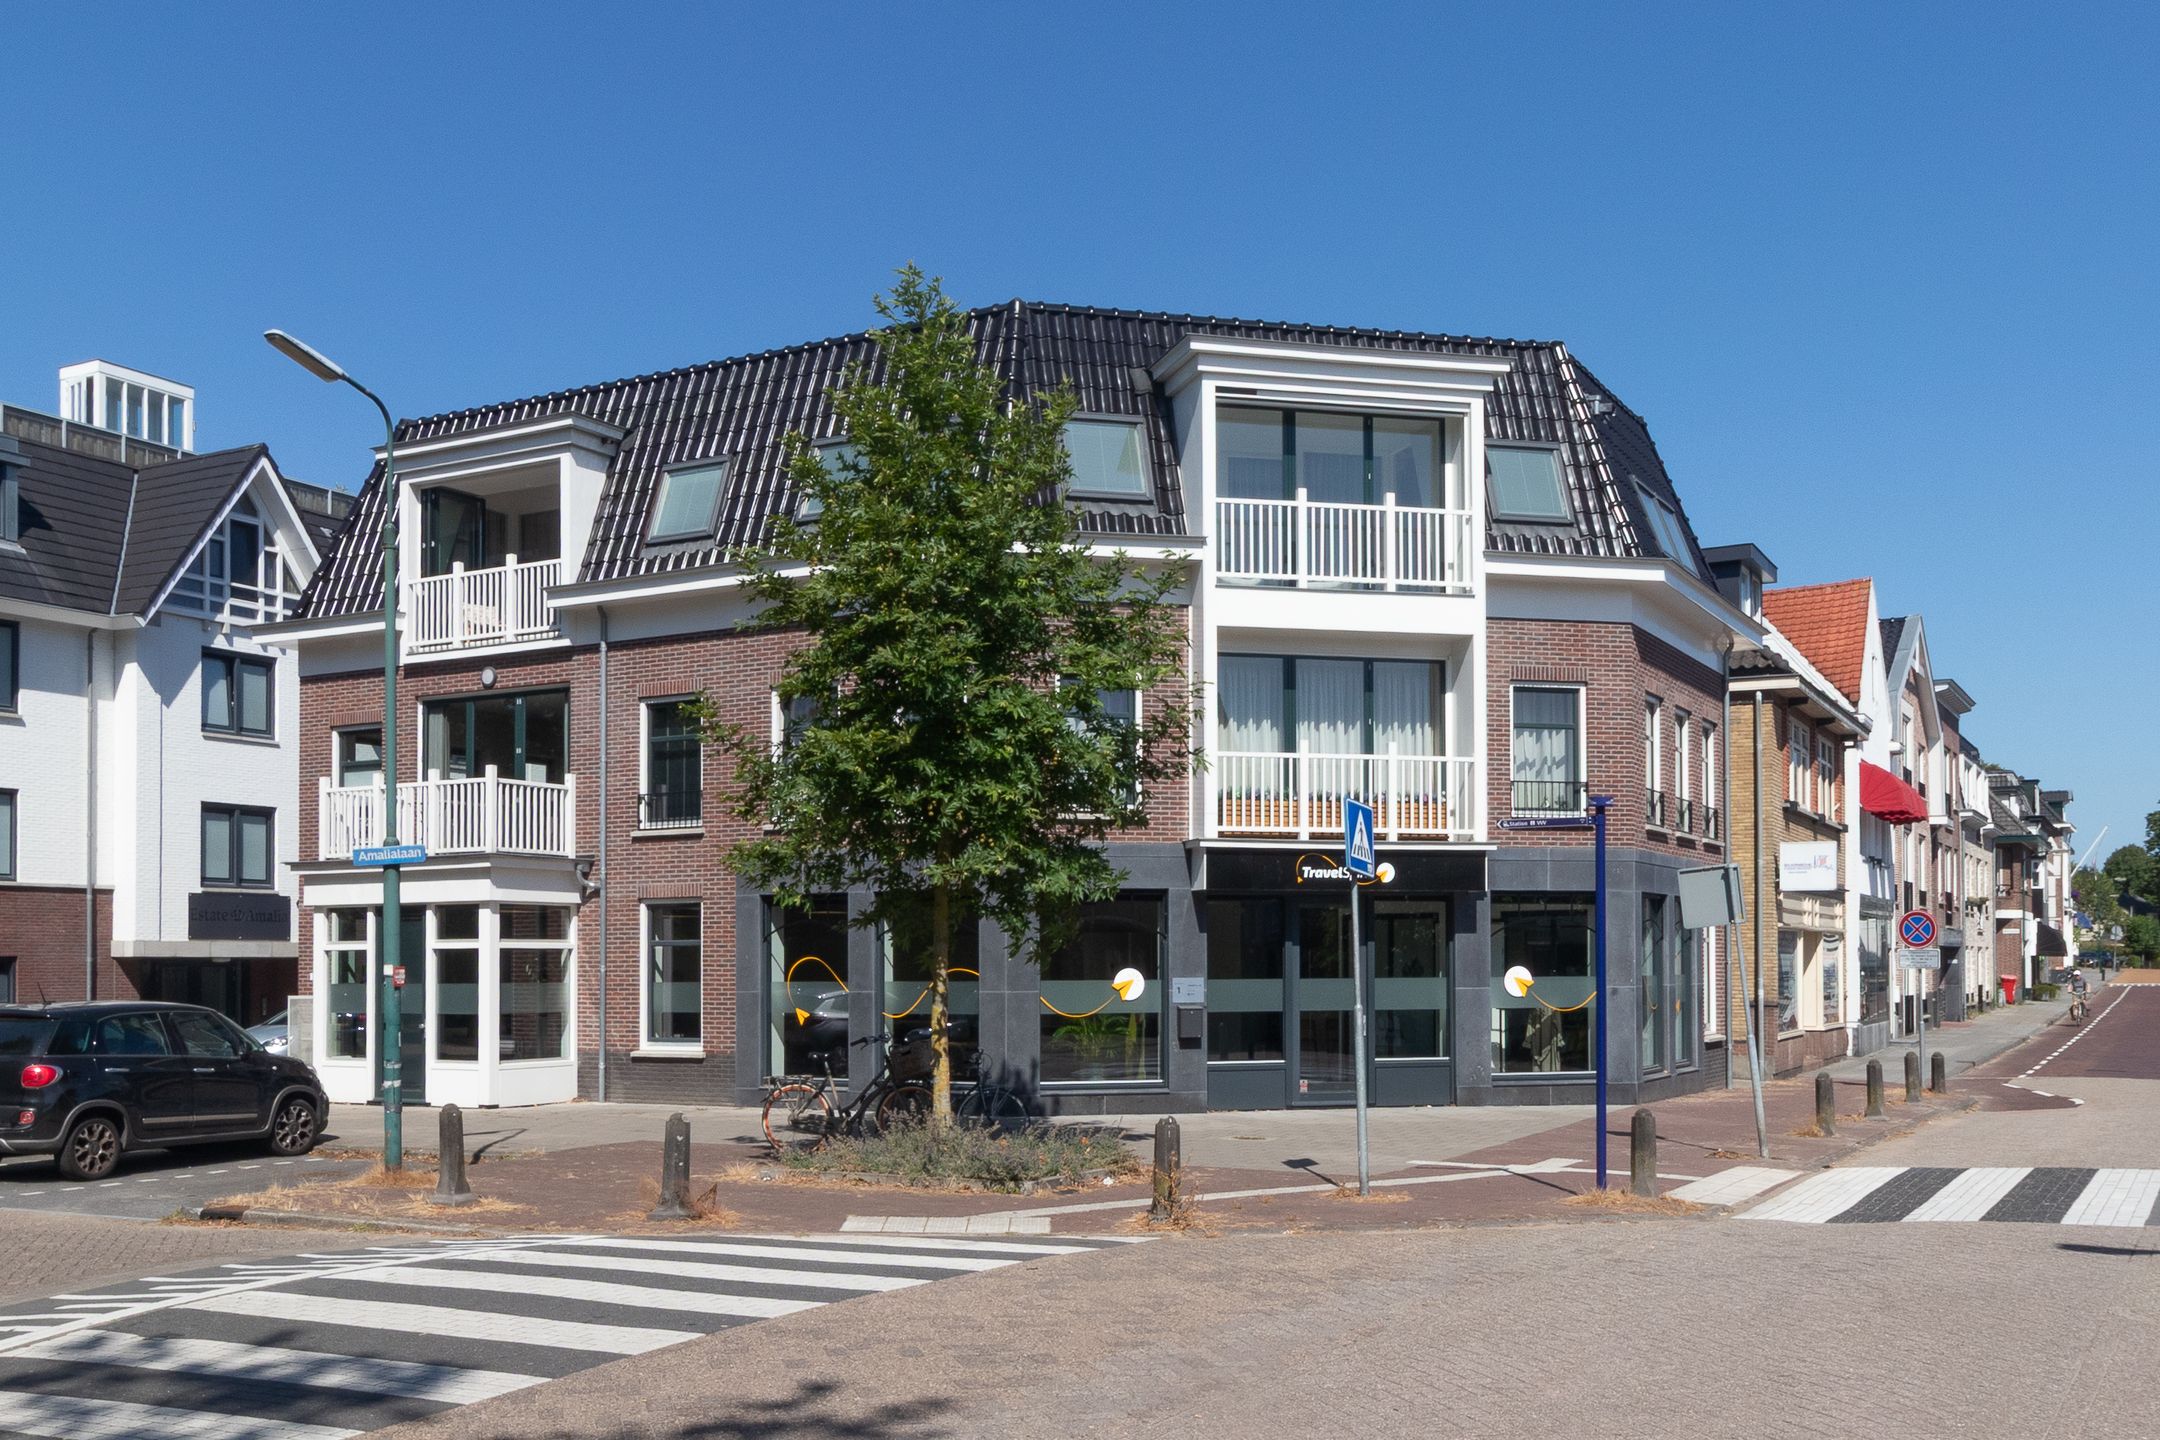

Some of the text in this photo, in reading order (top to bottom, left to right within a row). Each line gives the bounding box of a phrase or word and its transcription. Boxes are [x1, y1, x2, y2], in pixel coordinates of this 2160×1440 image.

[358, 848, 422, 861] Amalialaan
[190, 908, 288, 922] Estate Amalia
